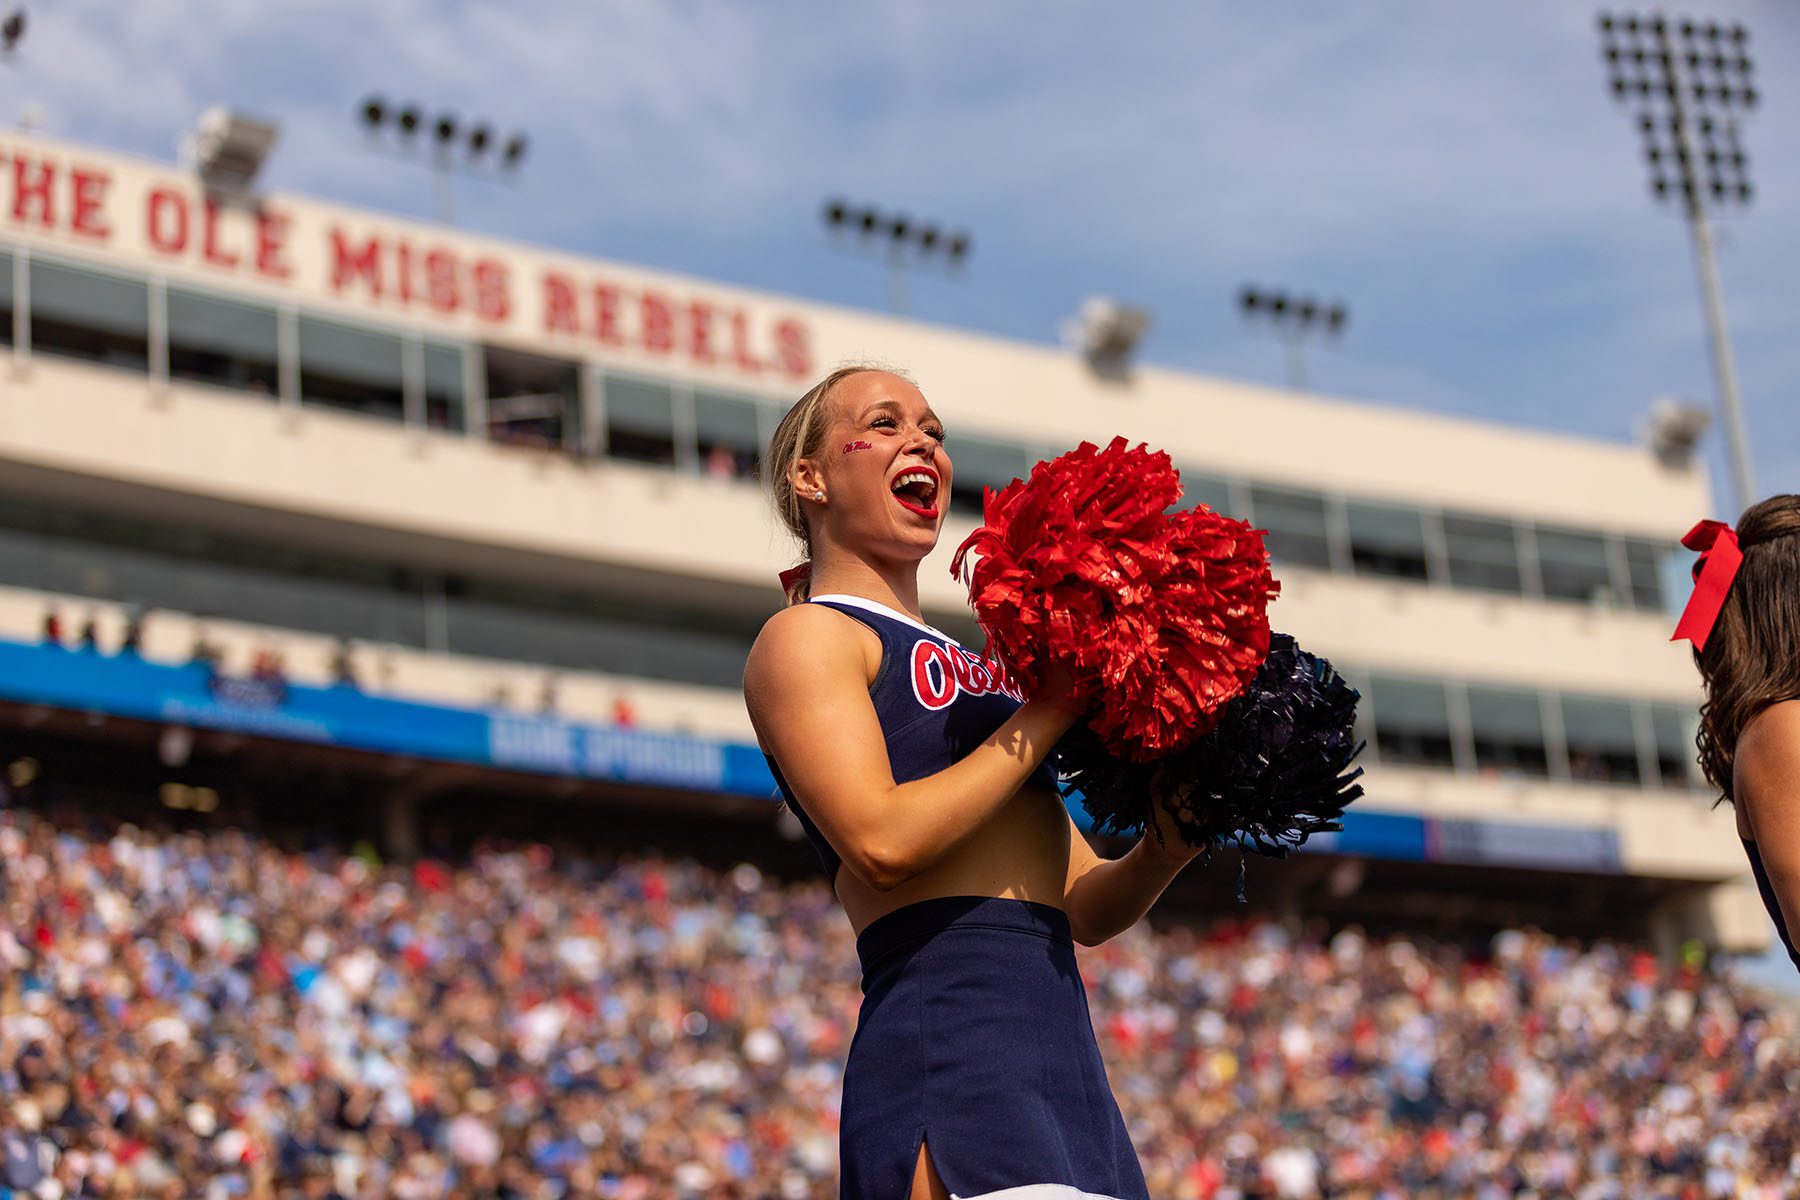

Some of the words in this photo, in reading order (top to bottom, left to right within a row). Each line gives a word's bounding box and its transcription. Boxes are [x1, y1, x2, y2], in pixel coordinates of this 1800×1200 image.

[0, 151, 114, 239] HE
[145, 184, 293, 280] OLE
[329, 221, 513, 325] MISS
[542, 268, 815, 380] REBELS
